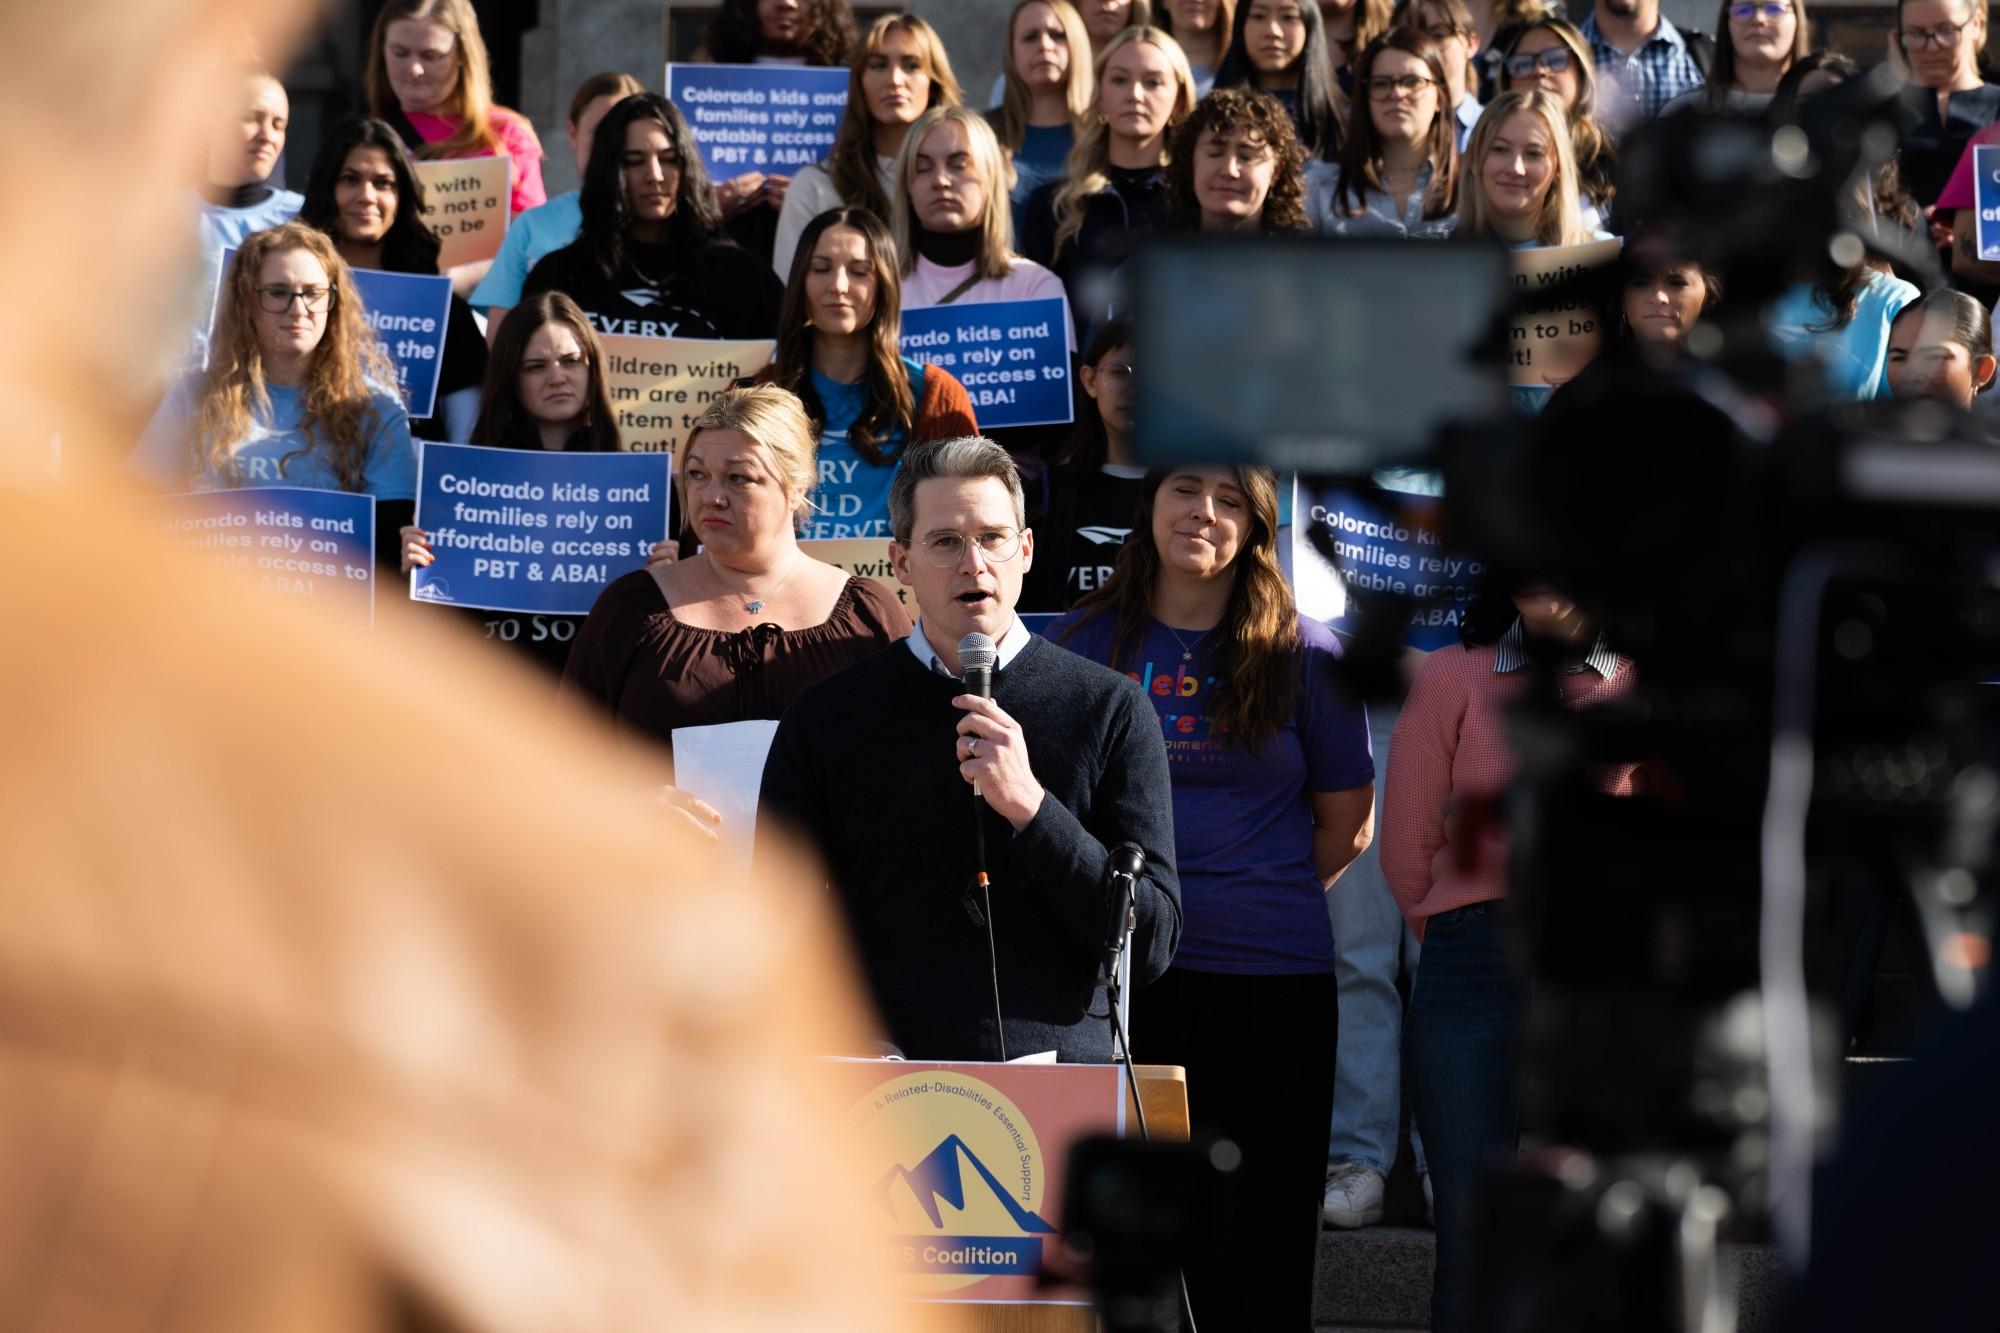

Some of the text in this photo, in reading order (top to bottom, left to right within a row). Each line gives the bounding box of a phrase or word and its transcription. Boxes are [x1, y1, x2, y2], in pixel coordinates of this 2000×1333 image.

[682, 86, 848, 106] Colorado kids and
[695, 106, 836, 128] families rely on
[692, 126, 836, 145] fordable access
[712, 147, 817, 164] PBT & ABA!
[434, 177, 481, 192] with
[444, 198, 478, 214] not
[484, 197, 496, 208] a
[460, 220, 484, 233] be
[899, 322, 1049, 348] rado kids and
[1535, 324, 1558, 338] to
[1569, 320, 1594, 335] be
[397, 340, 436, 360] the
[912, 346, 1036, 366] ilies rely on
[609, 356, 740, 378] ildren with
[962, 366, 1064, 386] access to
[649, 389, 688, 403] are
[619, 410, 672, 428] item
[630, 438, 676, 453] cut!
[440, 474, 650, 502] Colorado kids and
[255, 510, 304, 528] kids
[310, 518, 354, 534] and
[454, 502, 632, 534] families rely on
[1311, 505, 1409, 542] Colorado
[260, 533, 302, 554] rely
[310, 540, 338, 554] on
[425, 528, 544, 554] affordable
[552, 541, 631, 556] access
[258, 556, 336, 576] access
[344, 564, 368, 581] to
[854, 559, 895, 576] wit
[1333, 540, 1411, 570] amilies
[1418, 556, 1462, 578] rely
[474, 558, 606, 584] PBT & ABA!
[532, 614, 576, 642] SO
[993, 1106, 1028, 1152] Essential
[1020, 1154, 1032, 1201] Support
[923, 1247, 1018, 1265] Coalition
